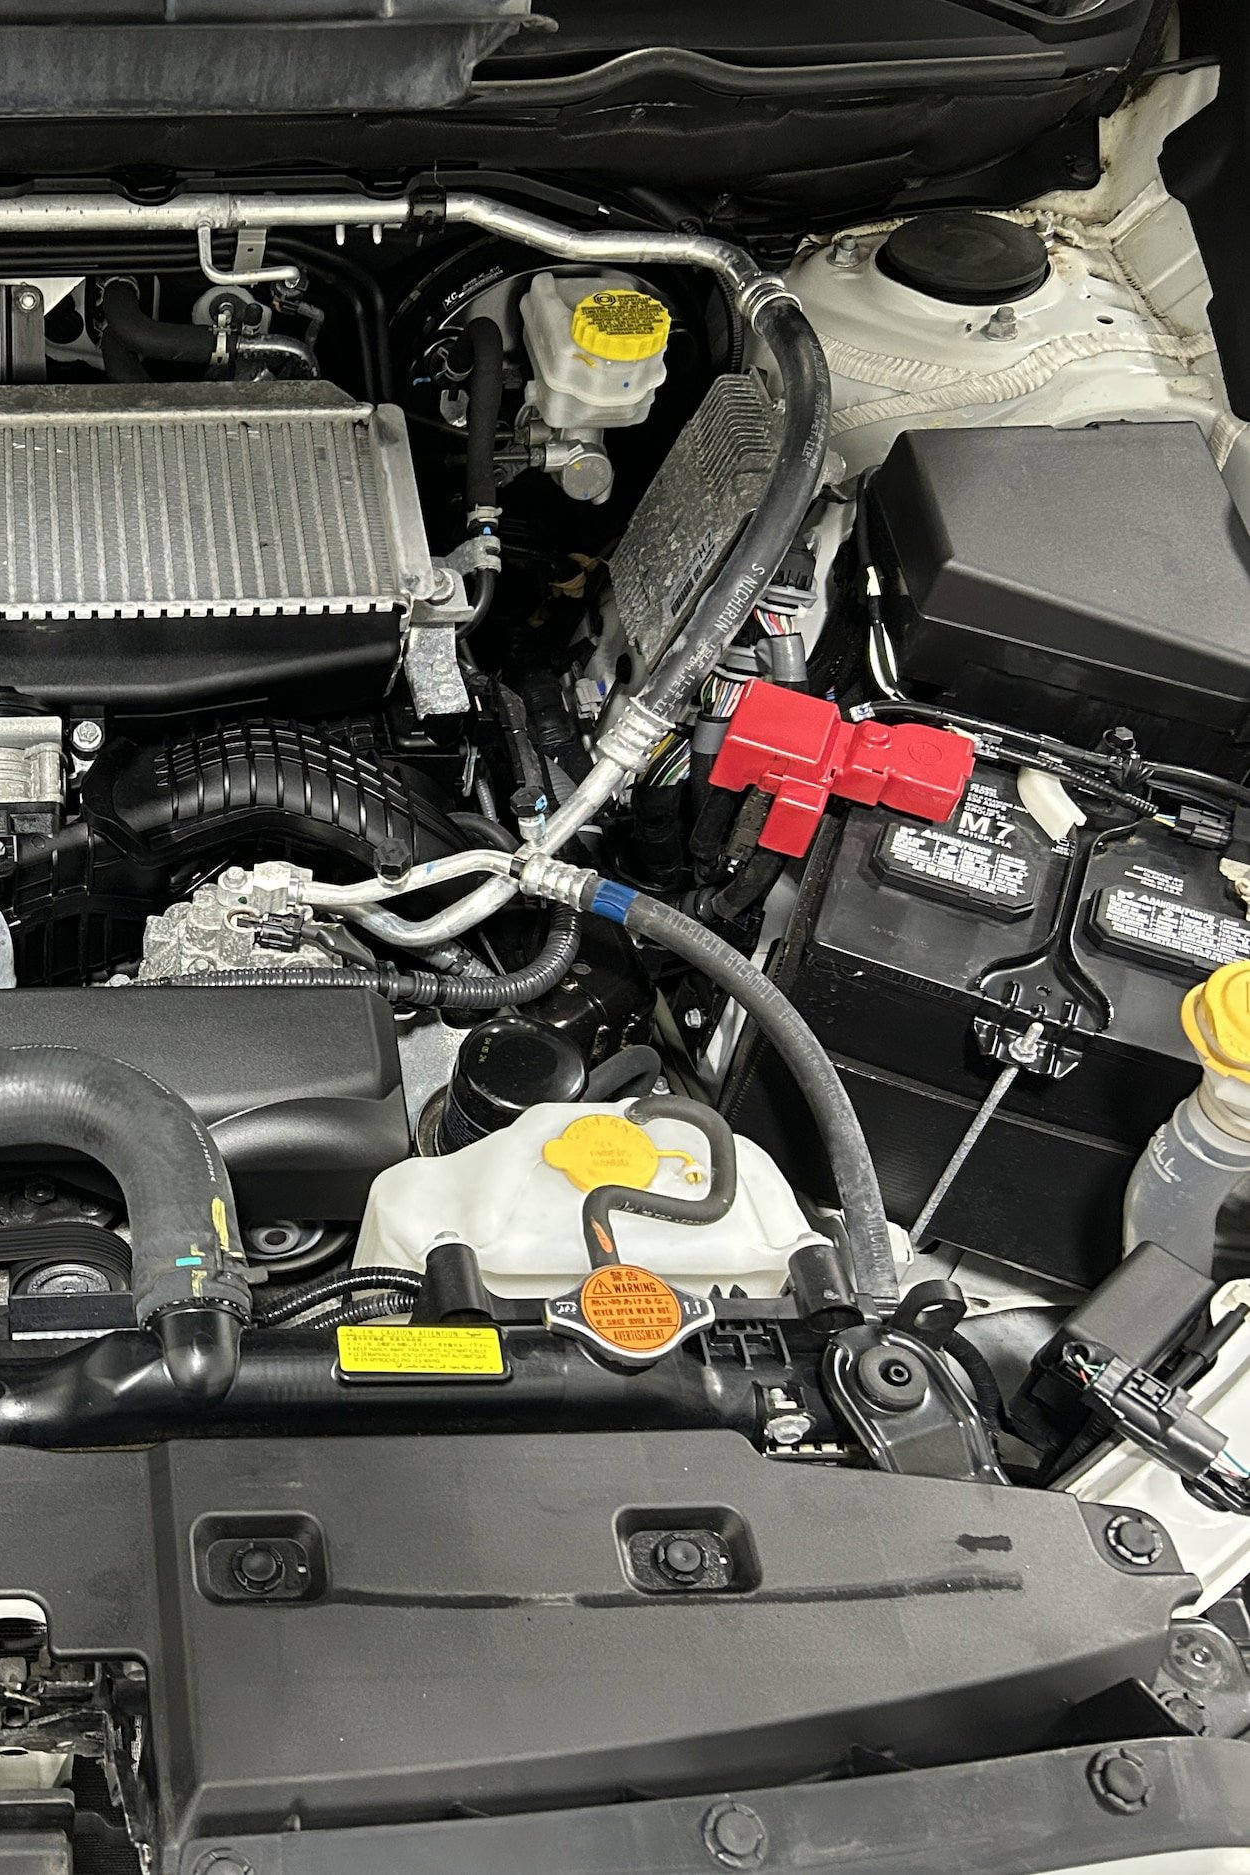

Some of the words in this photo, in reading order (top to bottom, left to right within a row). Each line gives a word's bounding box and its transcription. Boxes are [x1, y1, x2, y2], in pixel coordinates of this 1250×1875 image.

[964, 805, 995, 817] GROUP
[958, 811, 991, 835] M
[996, 820, 1016, 840] 7
[1150, 897, 1215, 921] DANGER/POISON
[610, 1271, 638, 1282] 警告
[613, 1282, 657, 1294] WARNING
[593, 1309, 614, 1317] NEVER
[616, 1308, 634, 1316] OPEN
[636, 1307, 655, 1315] WHEN
[381, 1329, 413, 1337] CAUTION
[419, 1330, 459, 1338] ATTENTION
